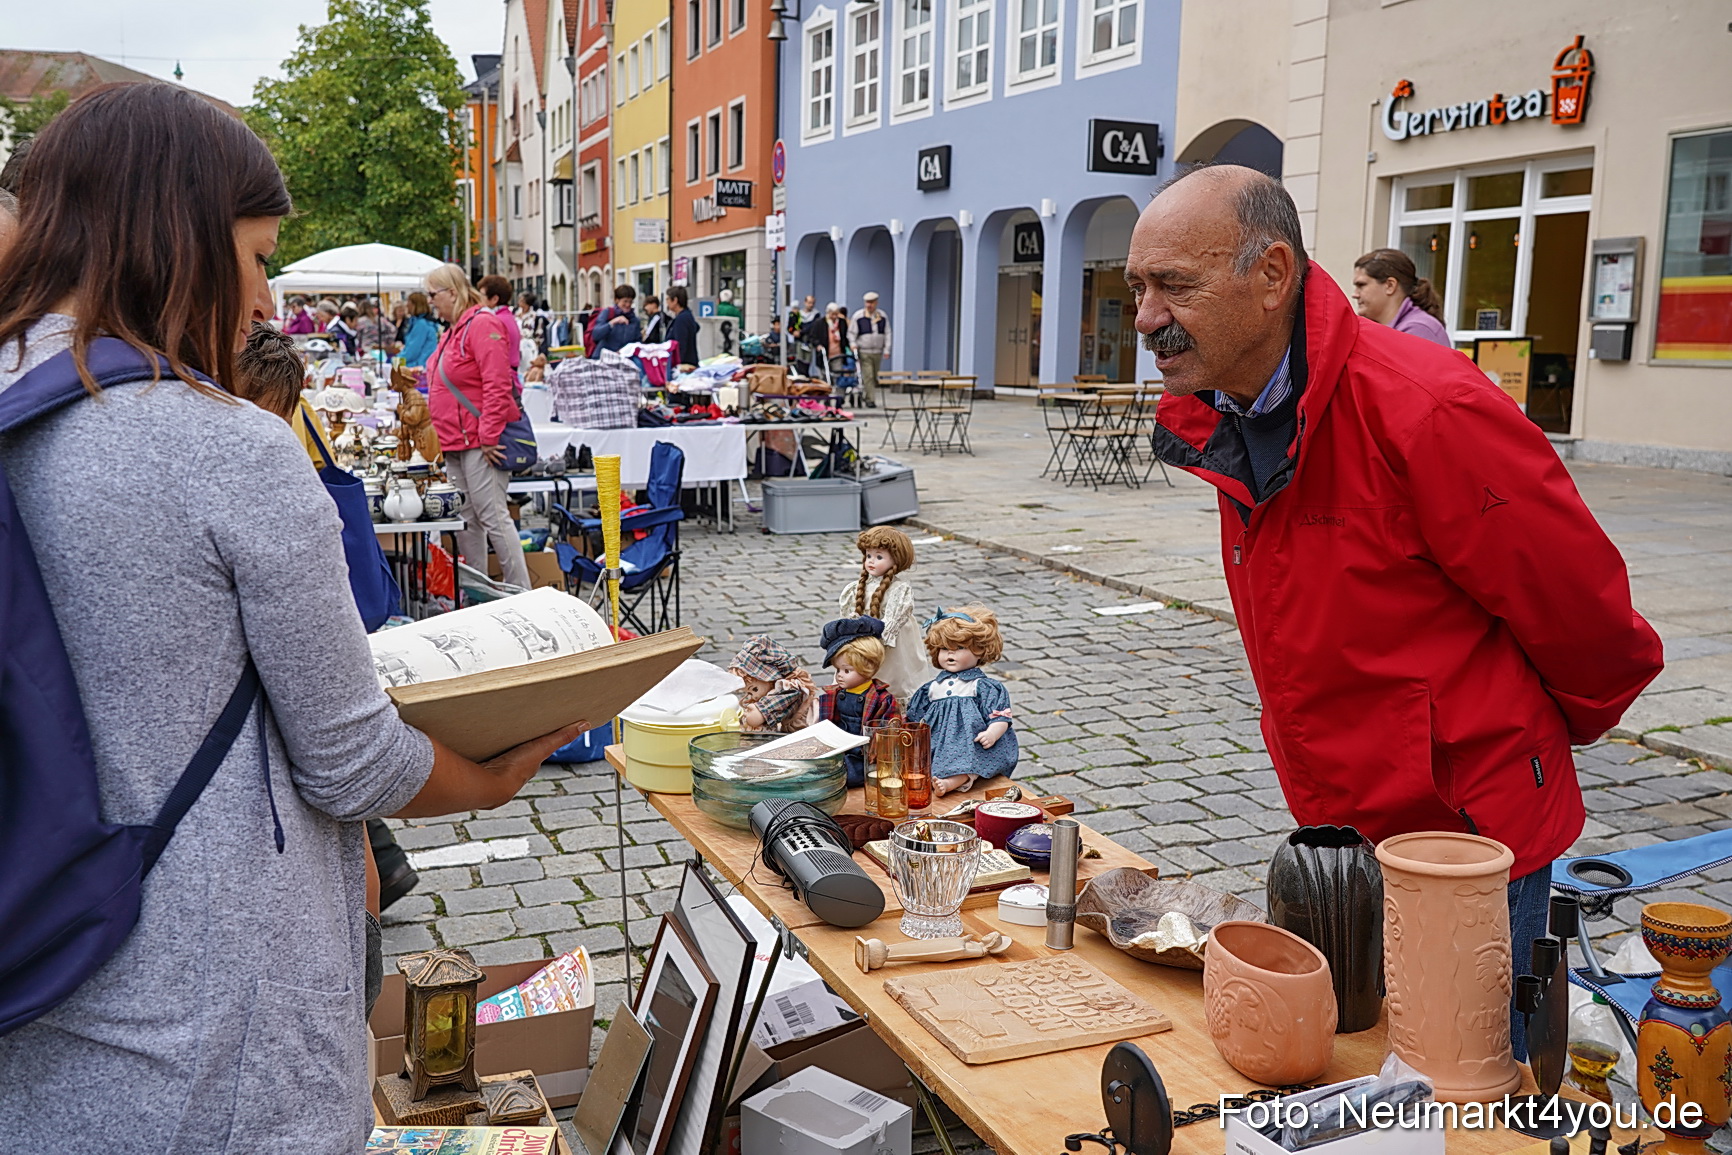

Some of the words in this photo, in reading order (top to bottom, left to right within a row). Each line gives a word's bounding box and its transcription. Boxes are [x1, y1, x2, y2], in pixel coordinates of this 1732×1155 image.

[1381, 86, 1543, 141] Gervintea
[1102, 130, 1150, 164] C&A
[717, 181, 751, 195] MATT
